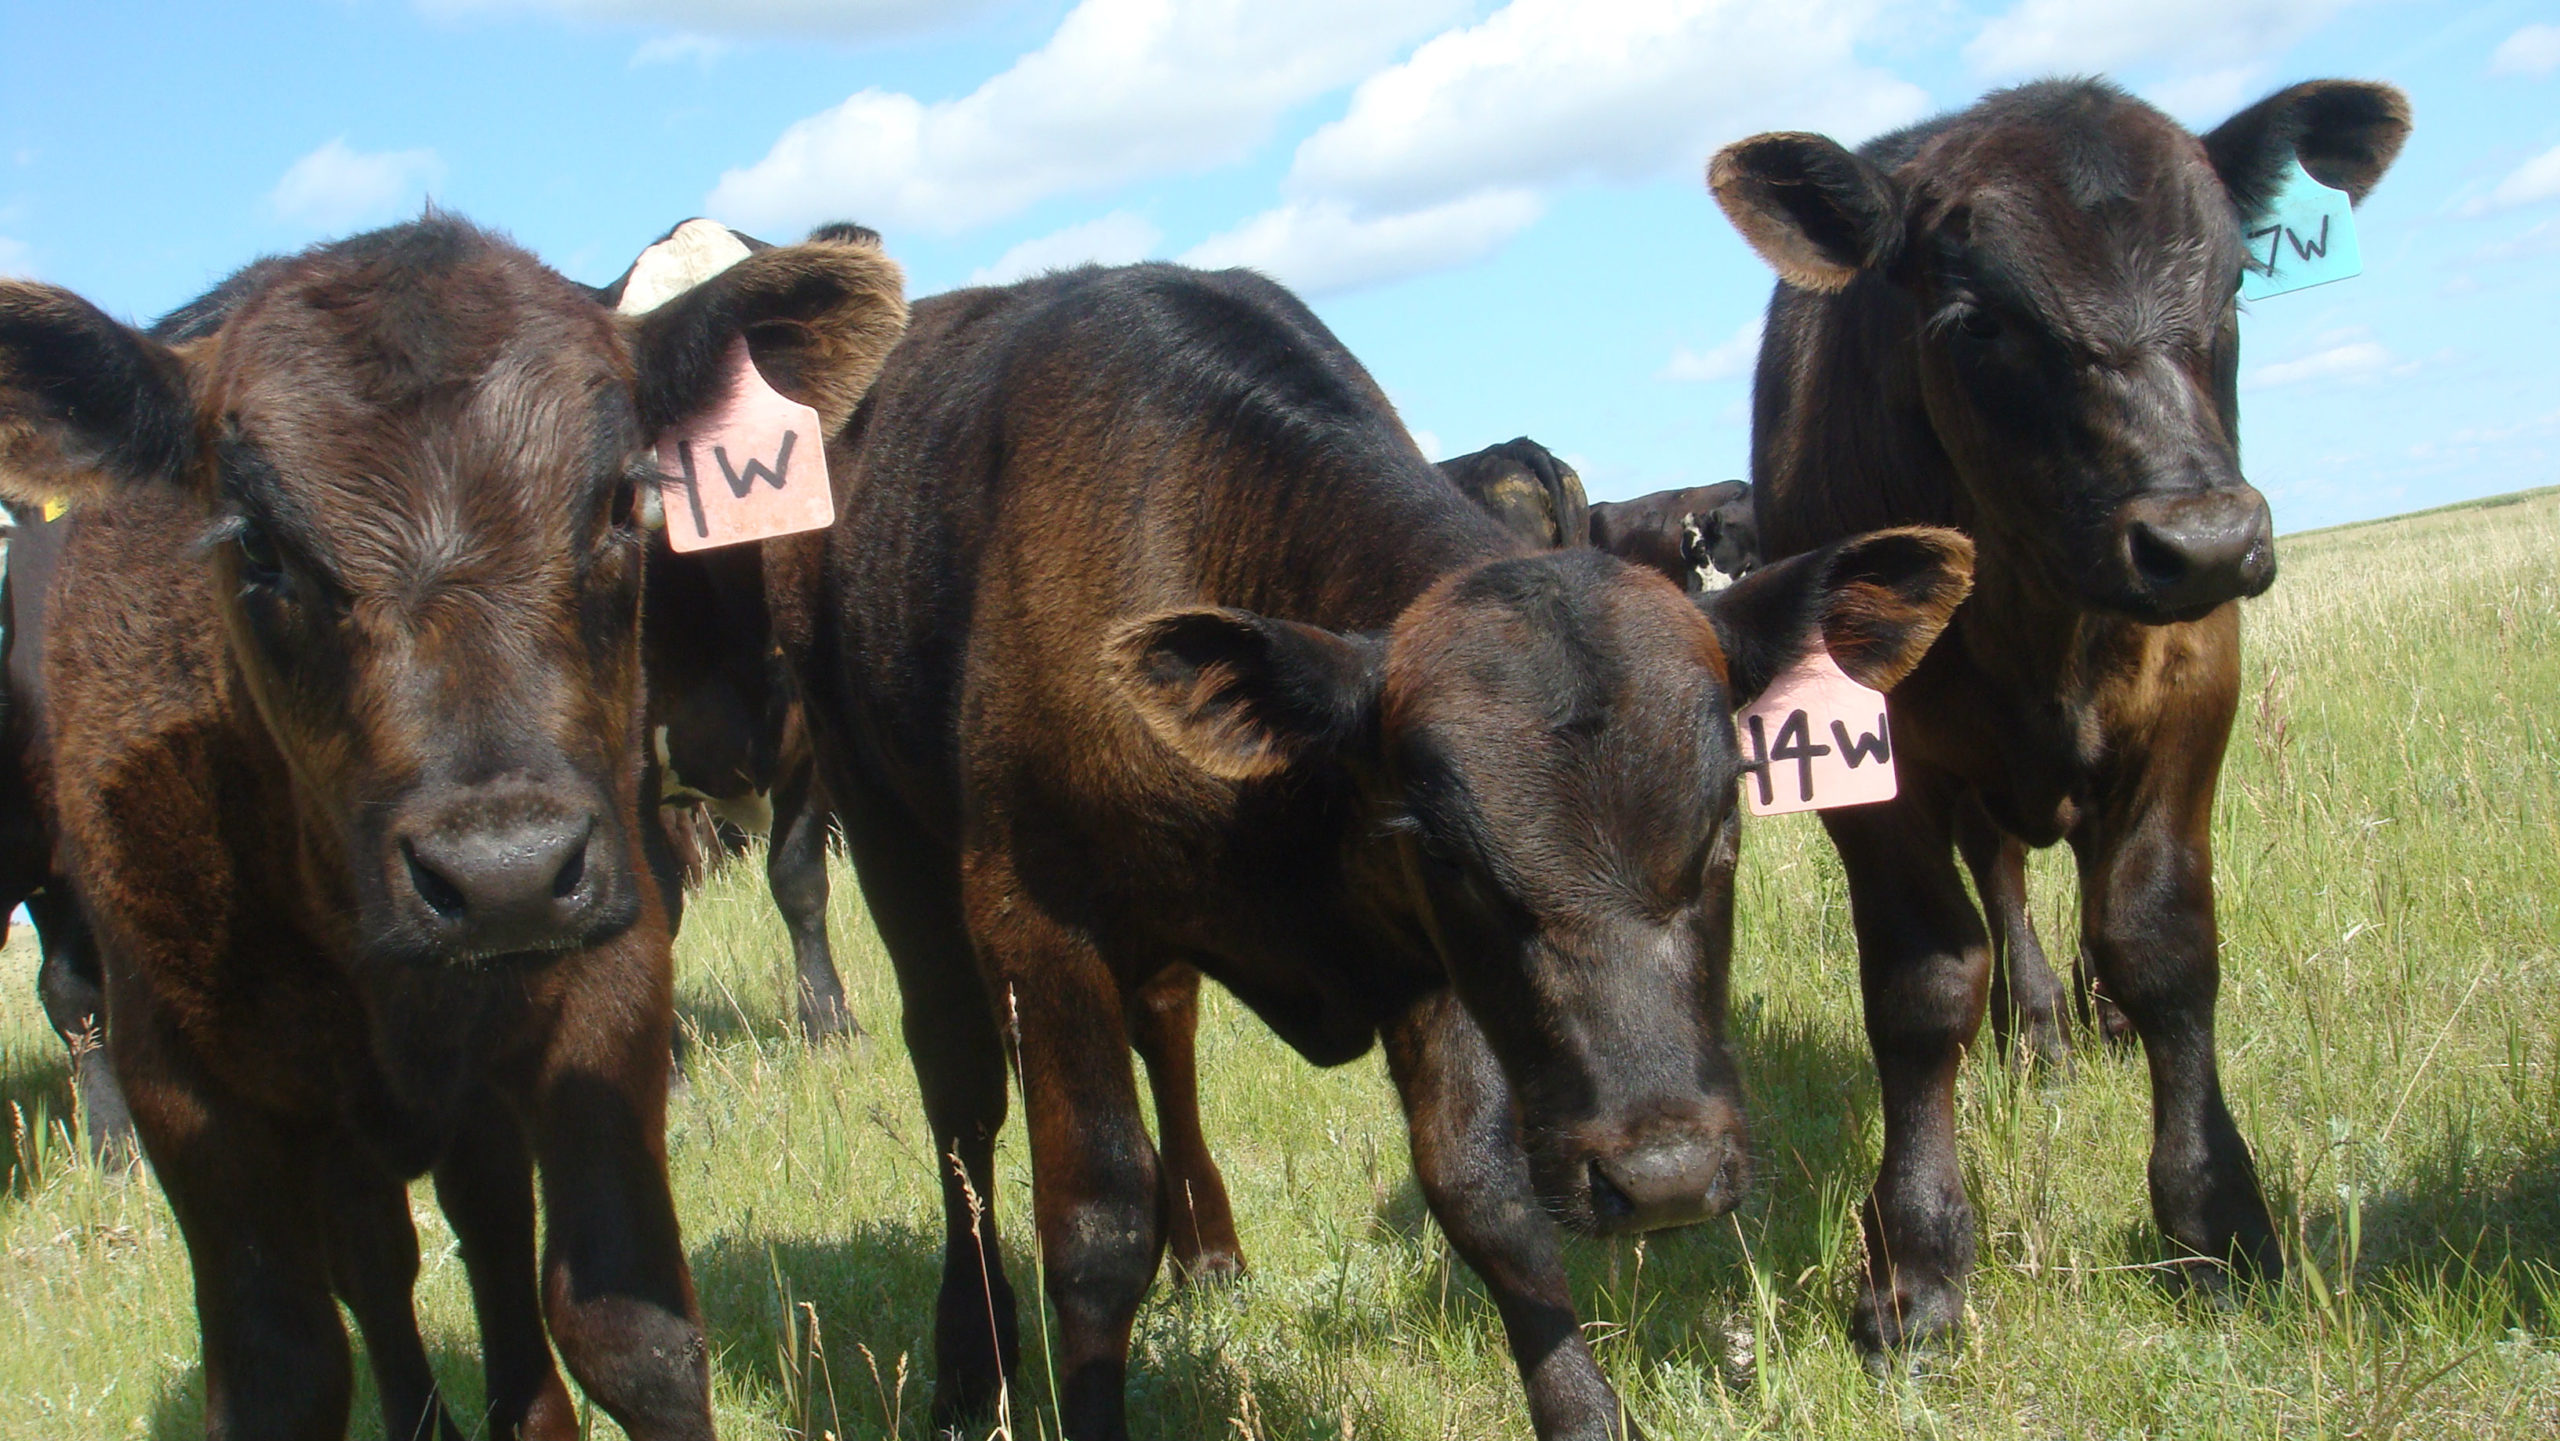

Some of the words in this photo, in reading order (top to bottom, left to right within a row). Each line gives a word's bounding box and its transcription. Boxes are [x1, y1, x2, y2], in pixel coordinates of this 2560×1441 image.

[2247, 214, 2329, 277] 7W
[677, 430, 798, 537] 1W
[1748, 709, 1890, 805] 14W
